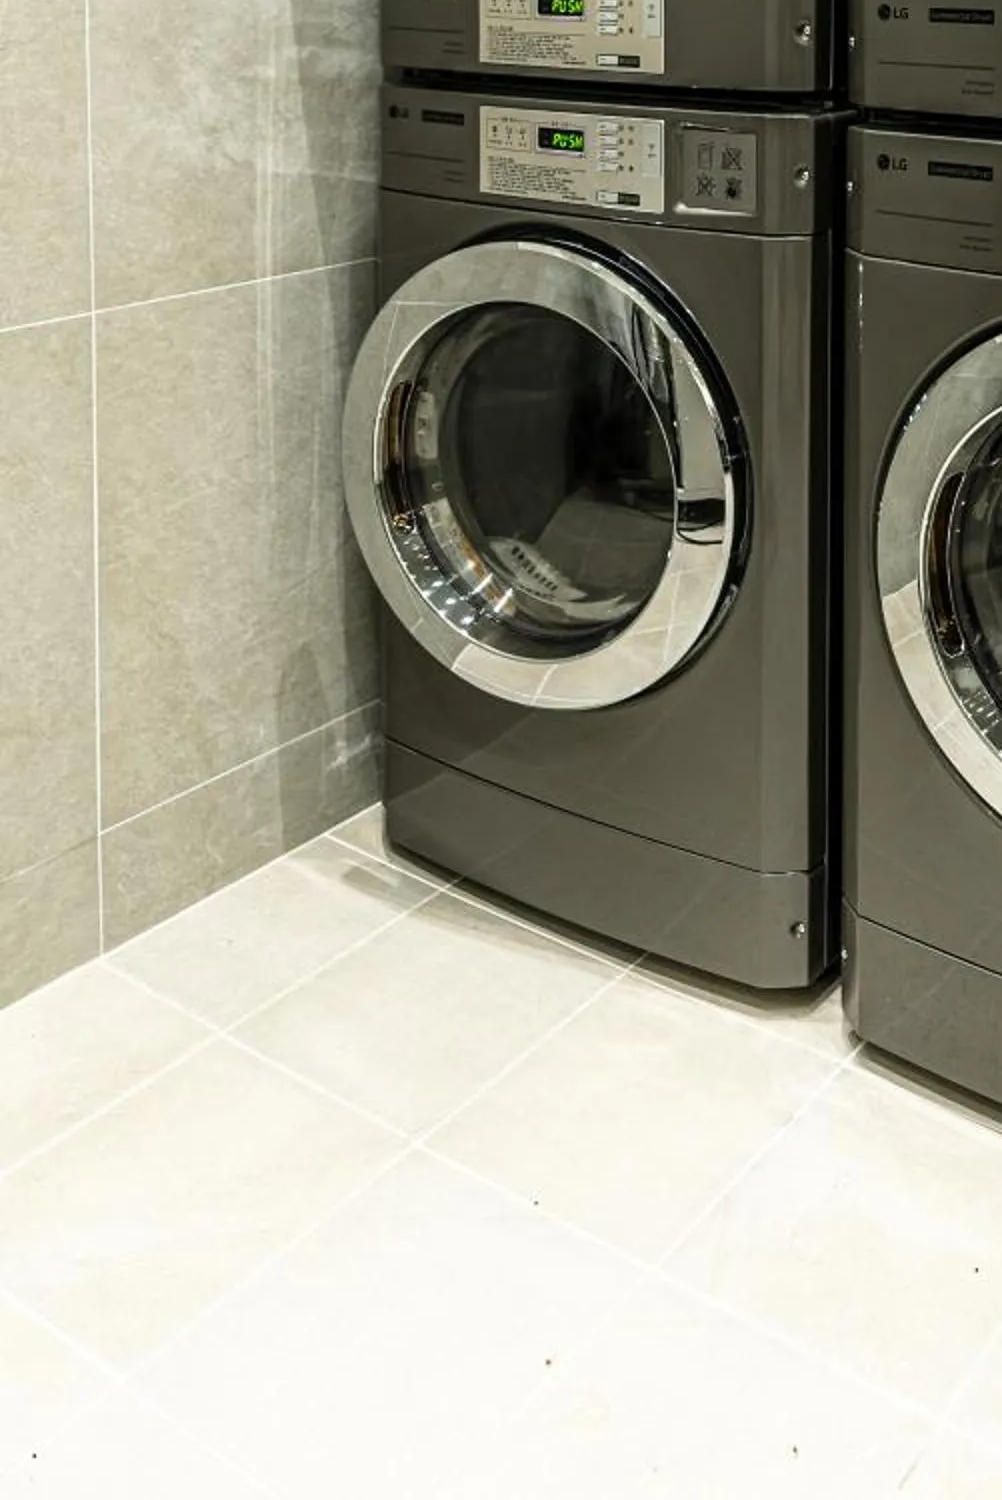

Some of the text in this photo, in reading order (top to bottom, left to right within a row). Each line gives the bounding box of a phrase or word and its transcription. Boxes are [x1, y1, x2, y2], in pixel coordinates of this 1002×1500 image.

[552, 0, 584, 14] PUSH
[893, 6, 910, 21] LG
[552, 133, 584, 149] PUSH
[892, 157, 908, 172] LG
